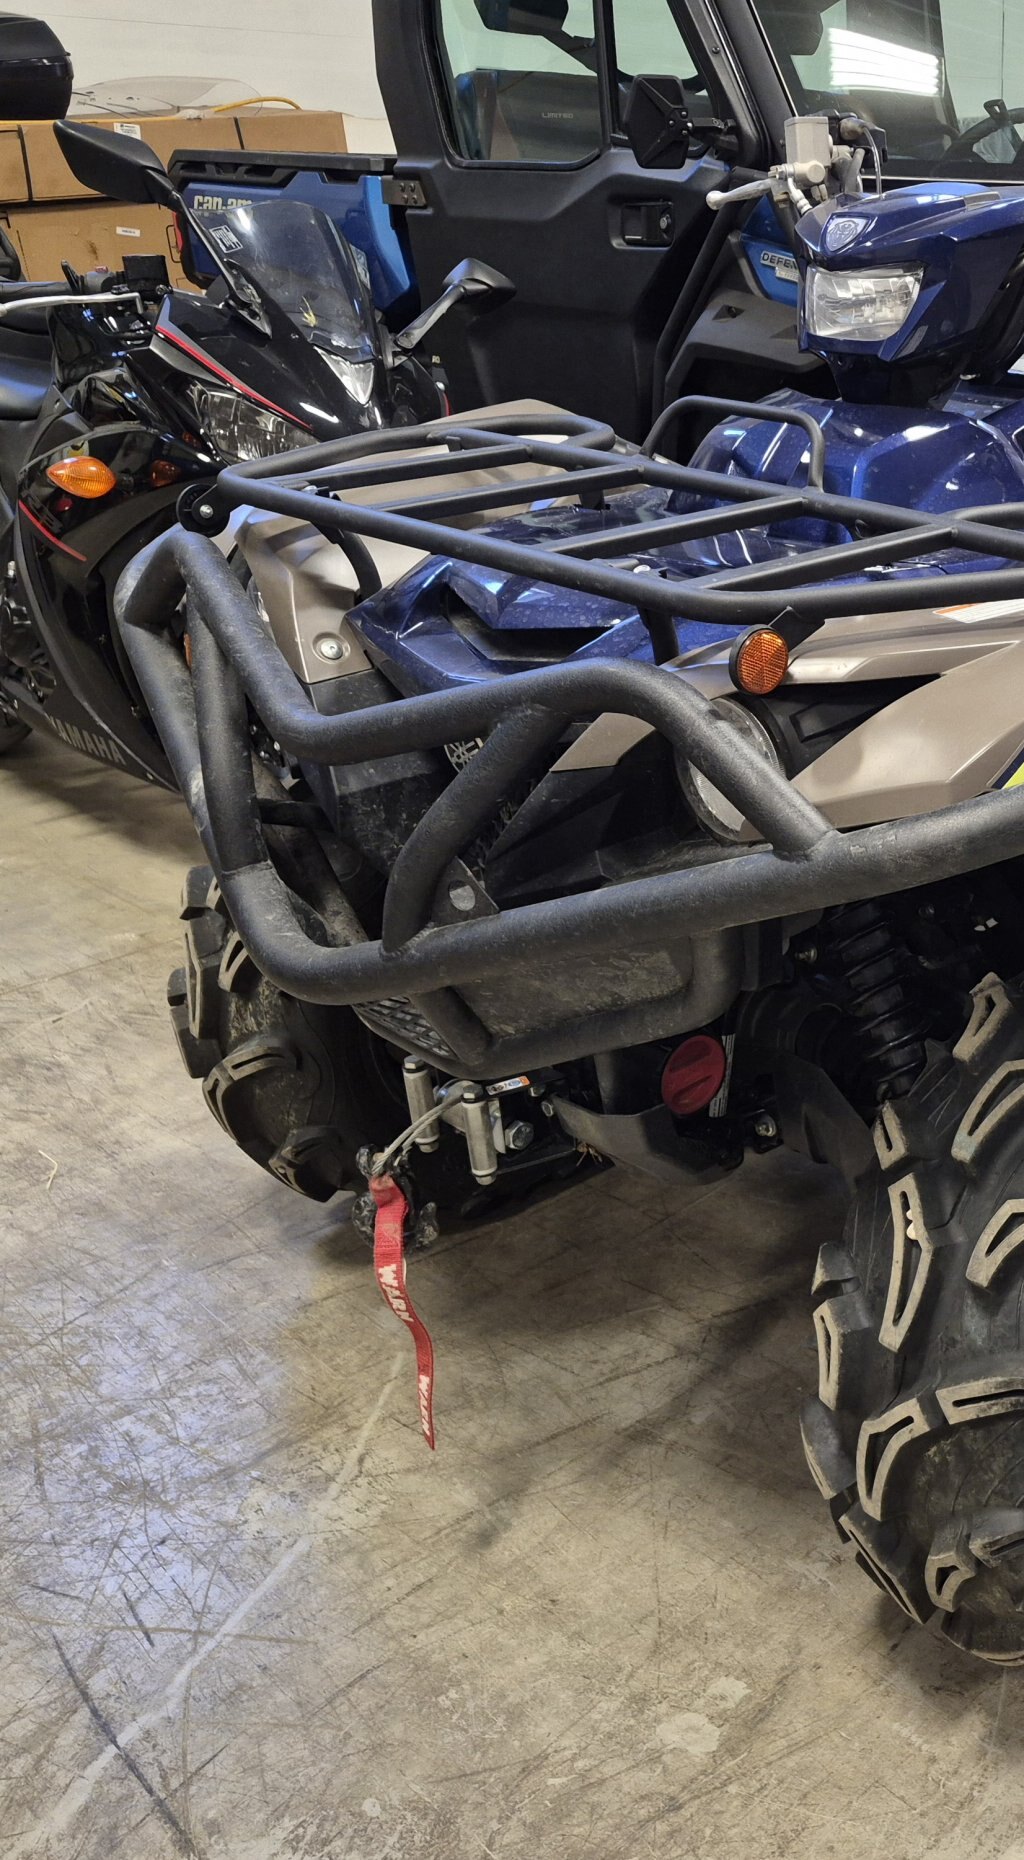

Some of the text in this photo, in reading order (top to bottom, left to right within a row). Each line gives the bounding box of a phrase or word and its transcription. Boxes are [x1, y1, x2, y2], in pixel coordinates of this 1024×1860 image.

[762, 252, 798, 270] DEFEN
[48, 714, 127, 766] YAMAHA
[378, 1263, 414, 1322] WARN
[418, 1374, 431, 1437] WARN
